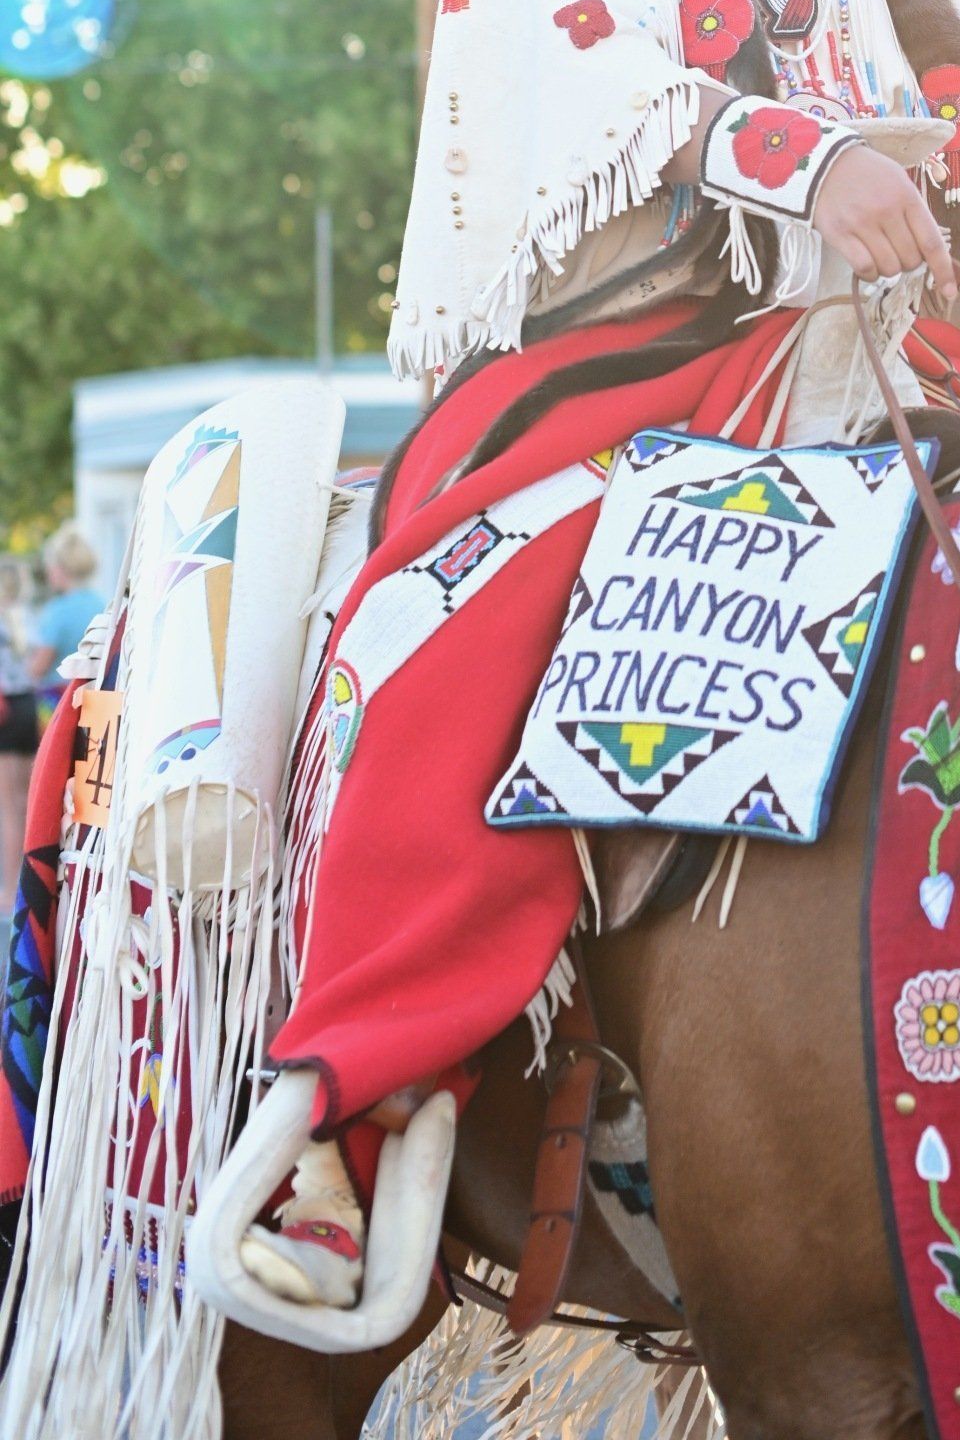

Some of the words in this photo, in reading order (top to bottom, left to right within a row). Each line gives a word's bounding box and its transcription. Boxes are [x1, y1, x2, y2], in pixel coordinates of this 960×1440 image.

[626, 504, 824, 582] HAPPY
[589, 575, 807, 654] CANYON
[533, 650, 817, 732] PRINCESS
